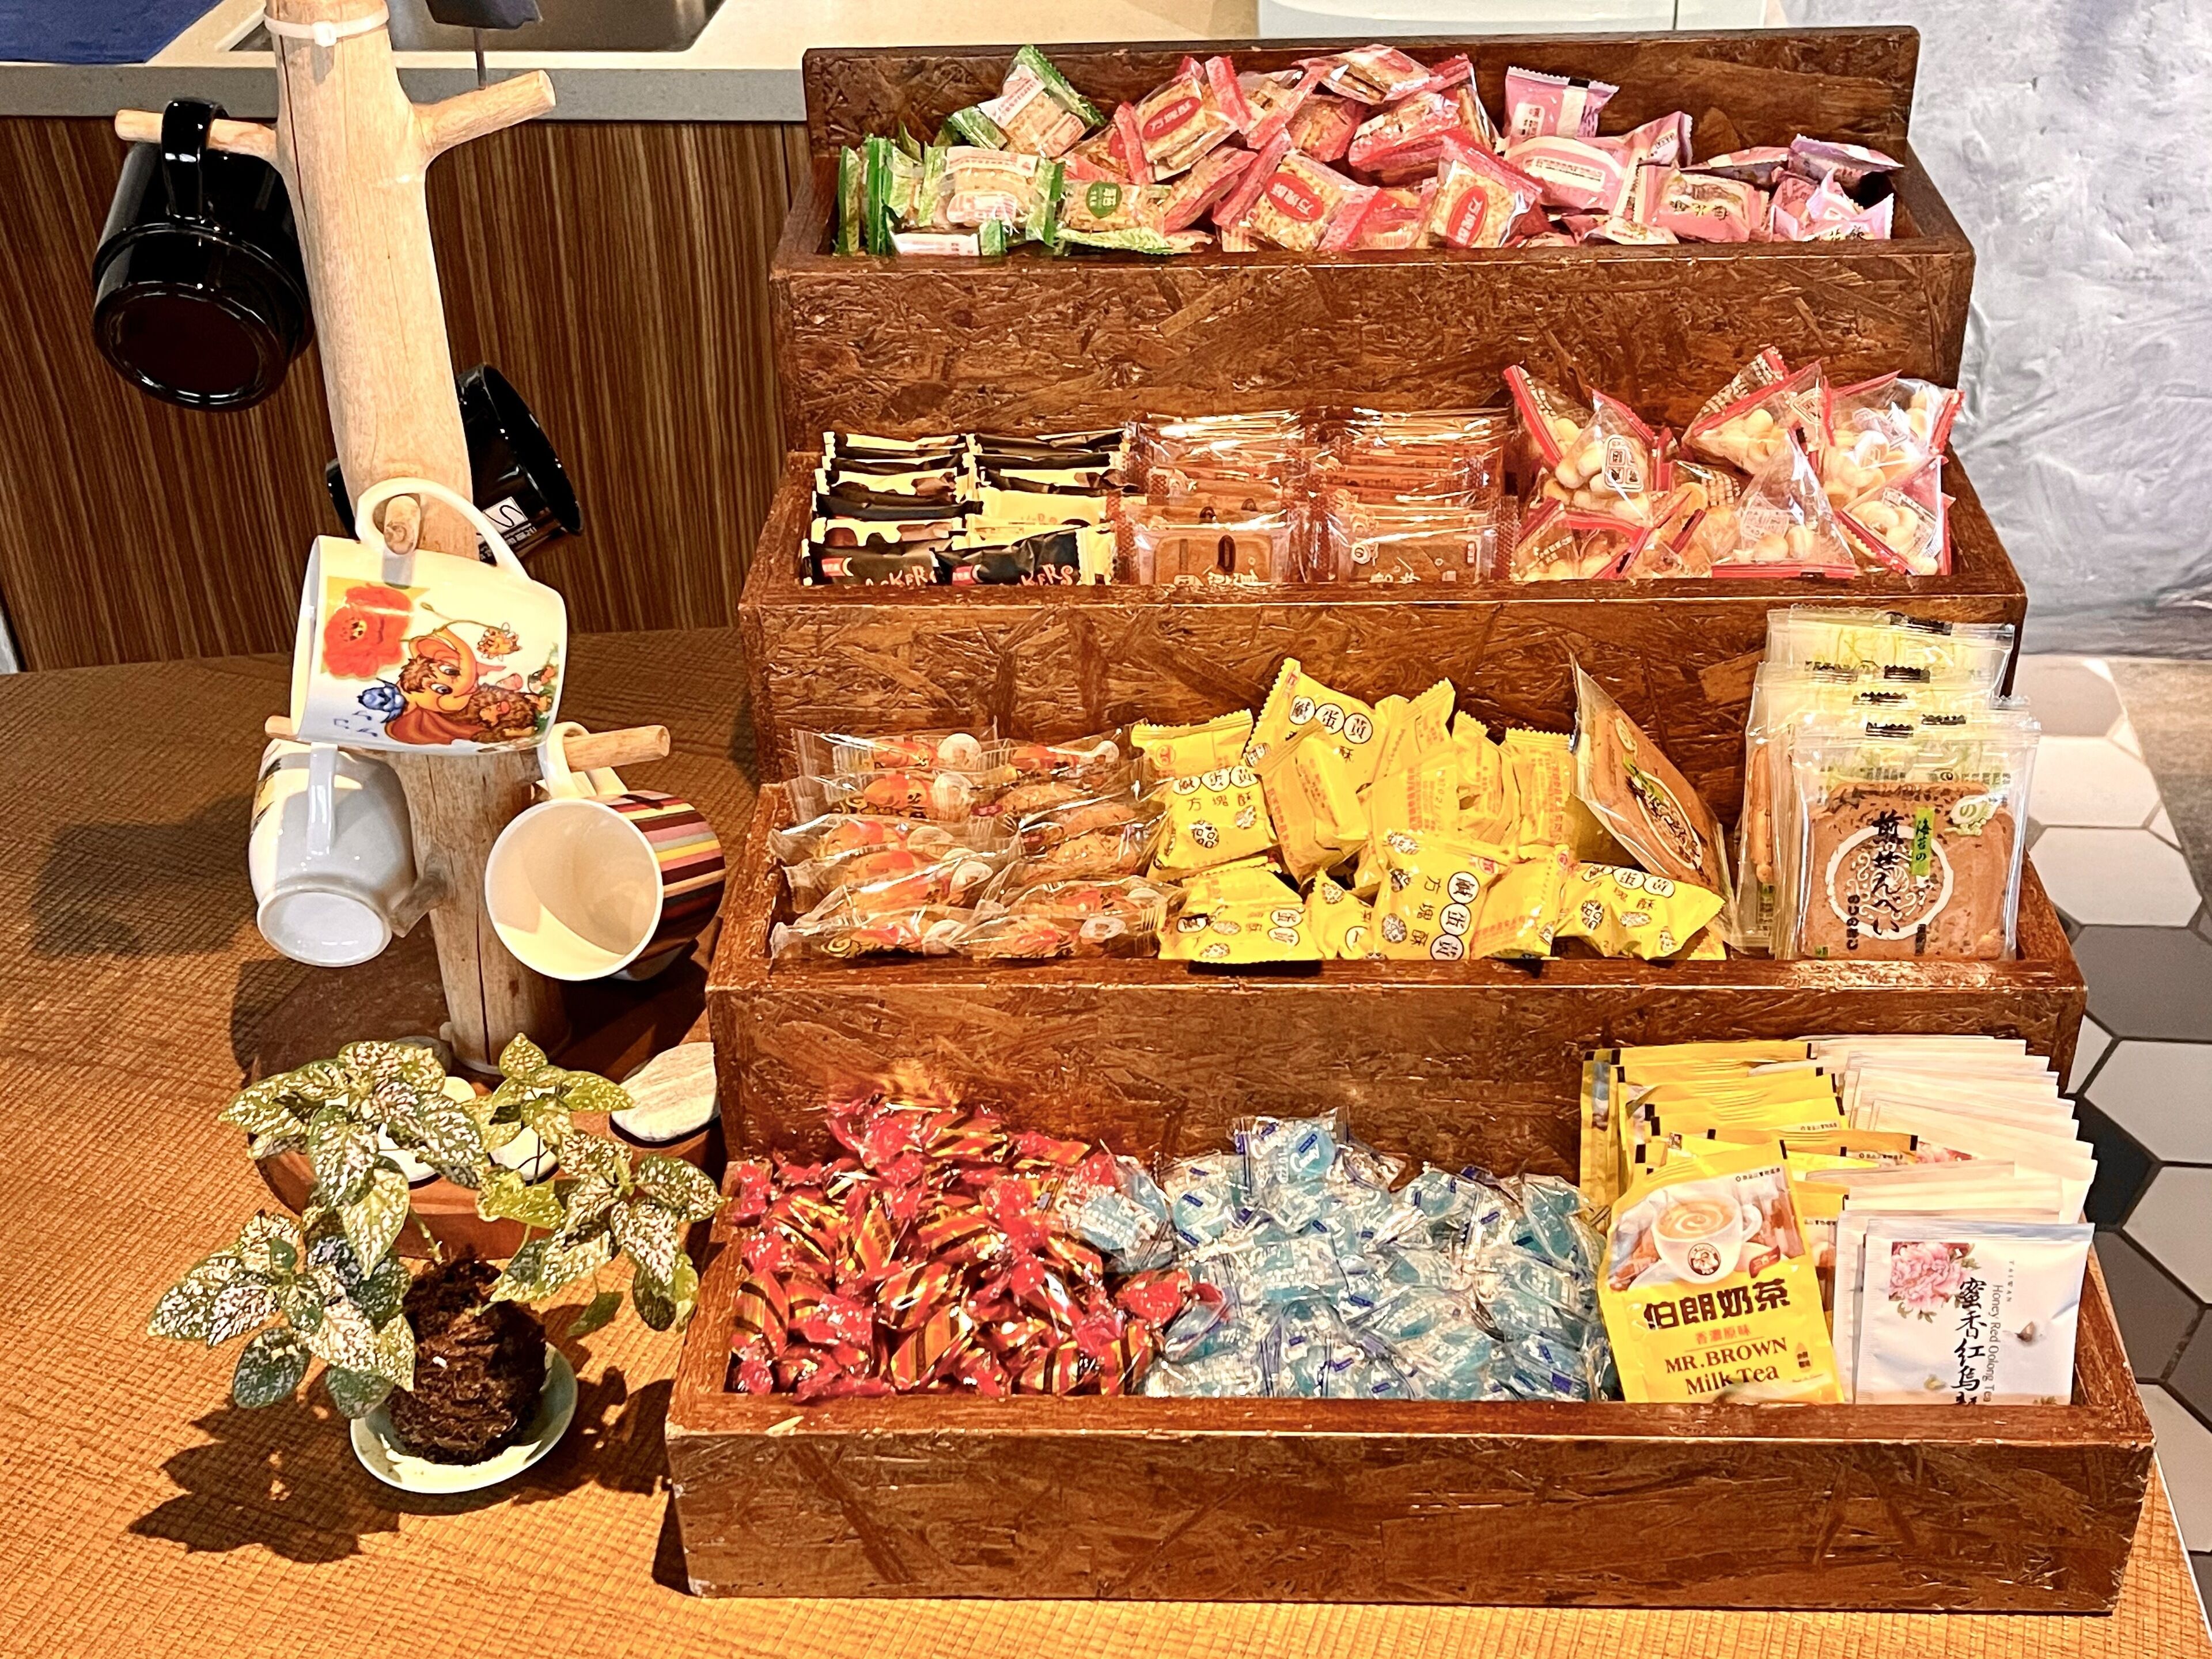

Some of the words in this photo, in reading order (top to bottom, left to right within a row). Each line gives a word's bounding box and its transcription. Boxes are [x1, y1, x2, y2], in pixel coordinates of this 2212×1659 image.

[1643, 1278, 1791, 1330] 伯朗奶茶
[1988, 1284, 2004, 1317] Honey
[1989, 1321, 2001, 1342] Red
[1982, 1345, 1999, 1381] Oolong
[1685, 1371, 1733, 1395] Milk
[1736, 1365, 1781, 1383] Tea
